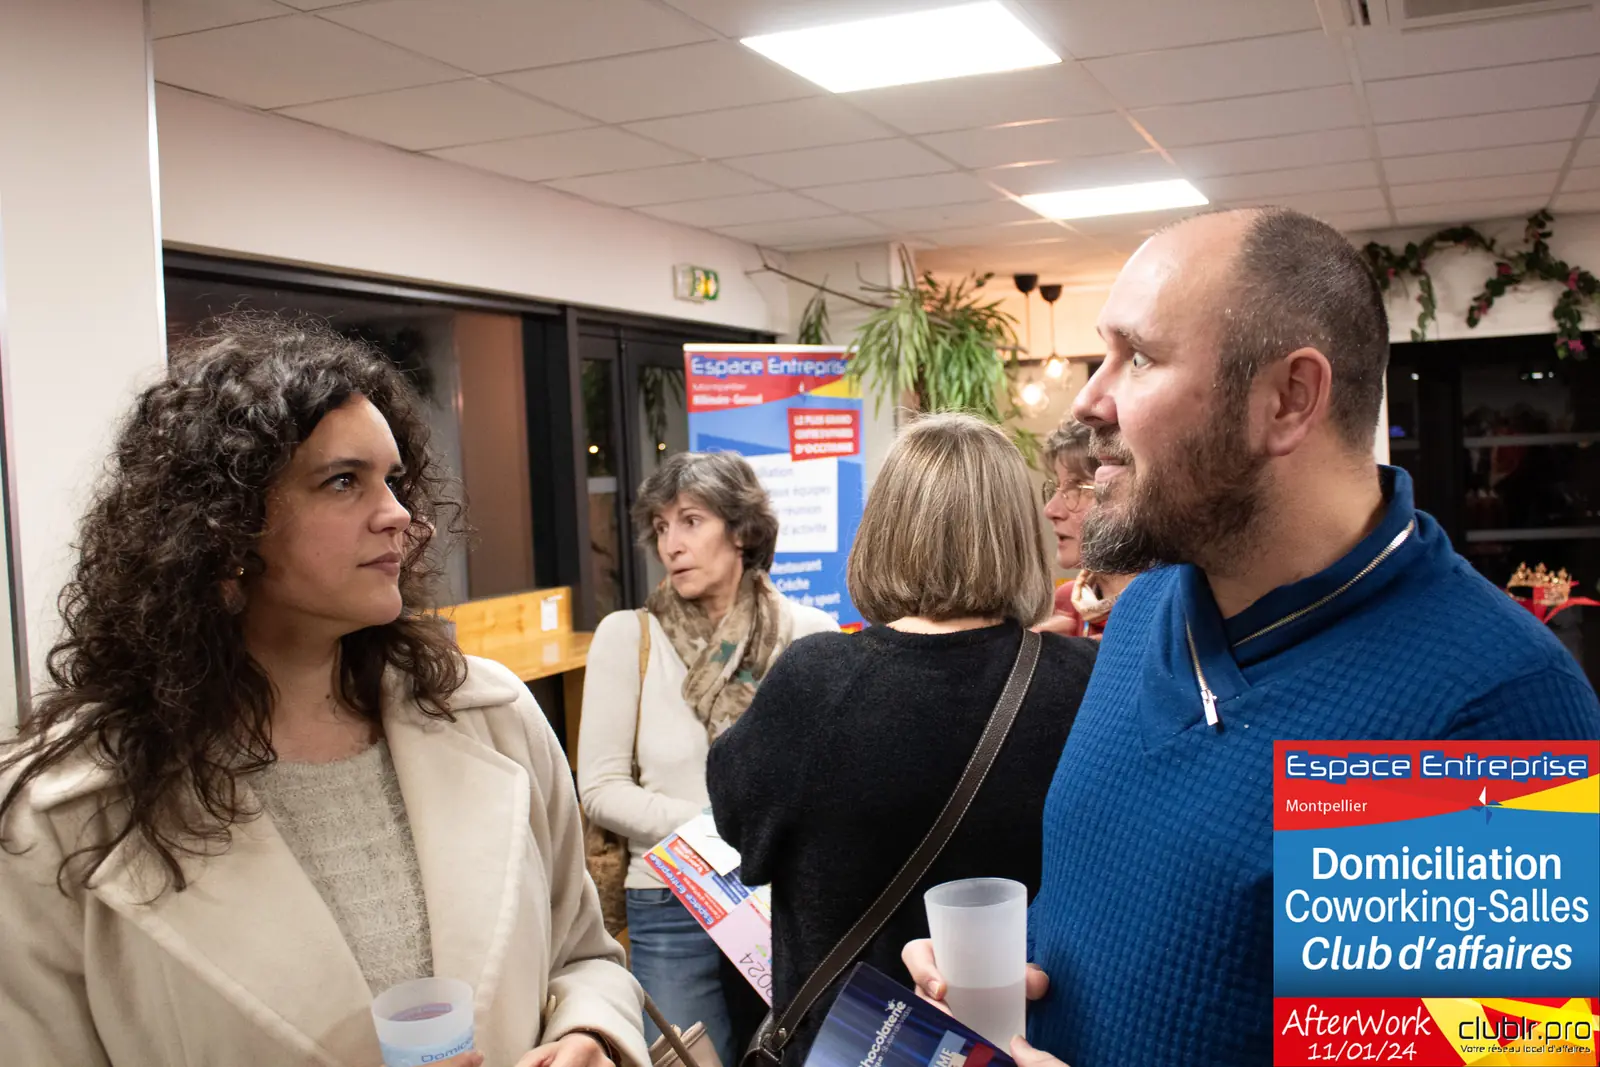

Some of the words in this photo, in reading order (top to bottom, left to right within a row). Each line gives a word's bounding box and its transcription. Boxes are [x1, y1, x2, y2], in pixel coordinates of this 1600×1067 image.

[691, 358, 762, 377] Espace
[768, 357, 852, 377] Entrepris
[650, 854, 686, 895] Entreprise
[685, 893, 714, 926] Espace
